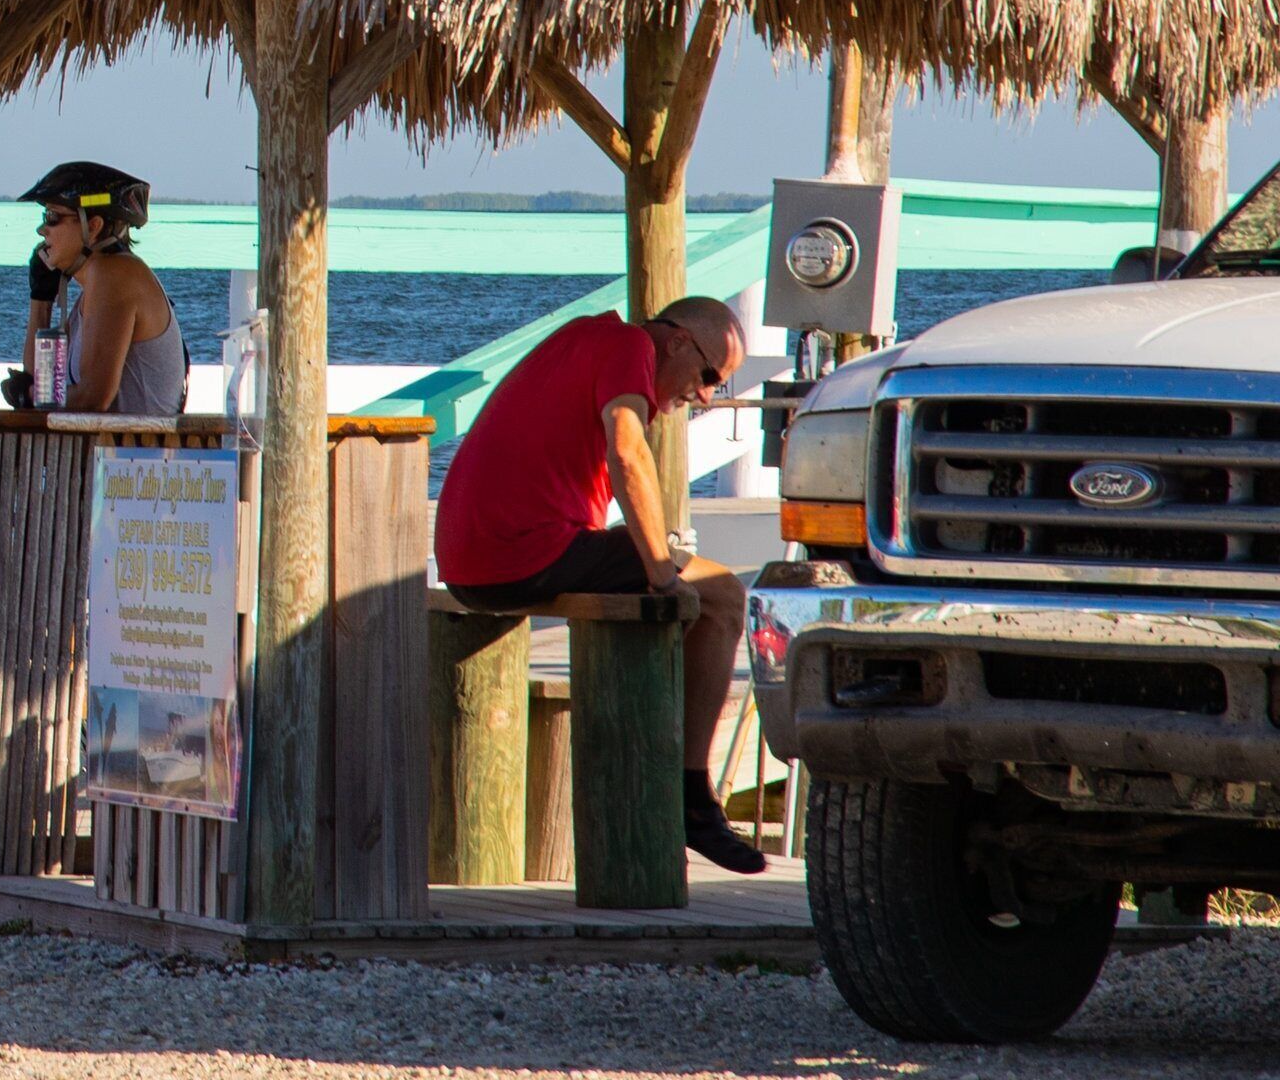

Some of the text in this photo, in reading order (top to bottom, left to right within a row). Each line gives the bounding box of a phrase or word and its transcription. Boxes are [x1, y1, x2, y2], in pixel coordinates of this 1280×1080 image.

[1088, 472, 1132, 497] Ford
[118, 519, 210, 548] CAPTAIN CATHY EAGLE
[115, 547, 212, 601] (239) 994-2572
